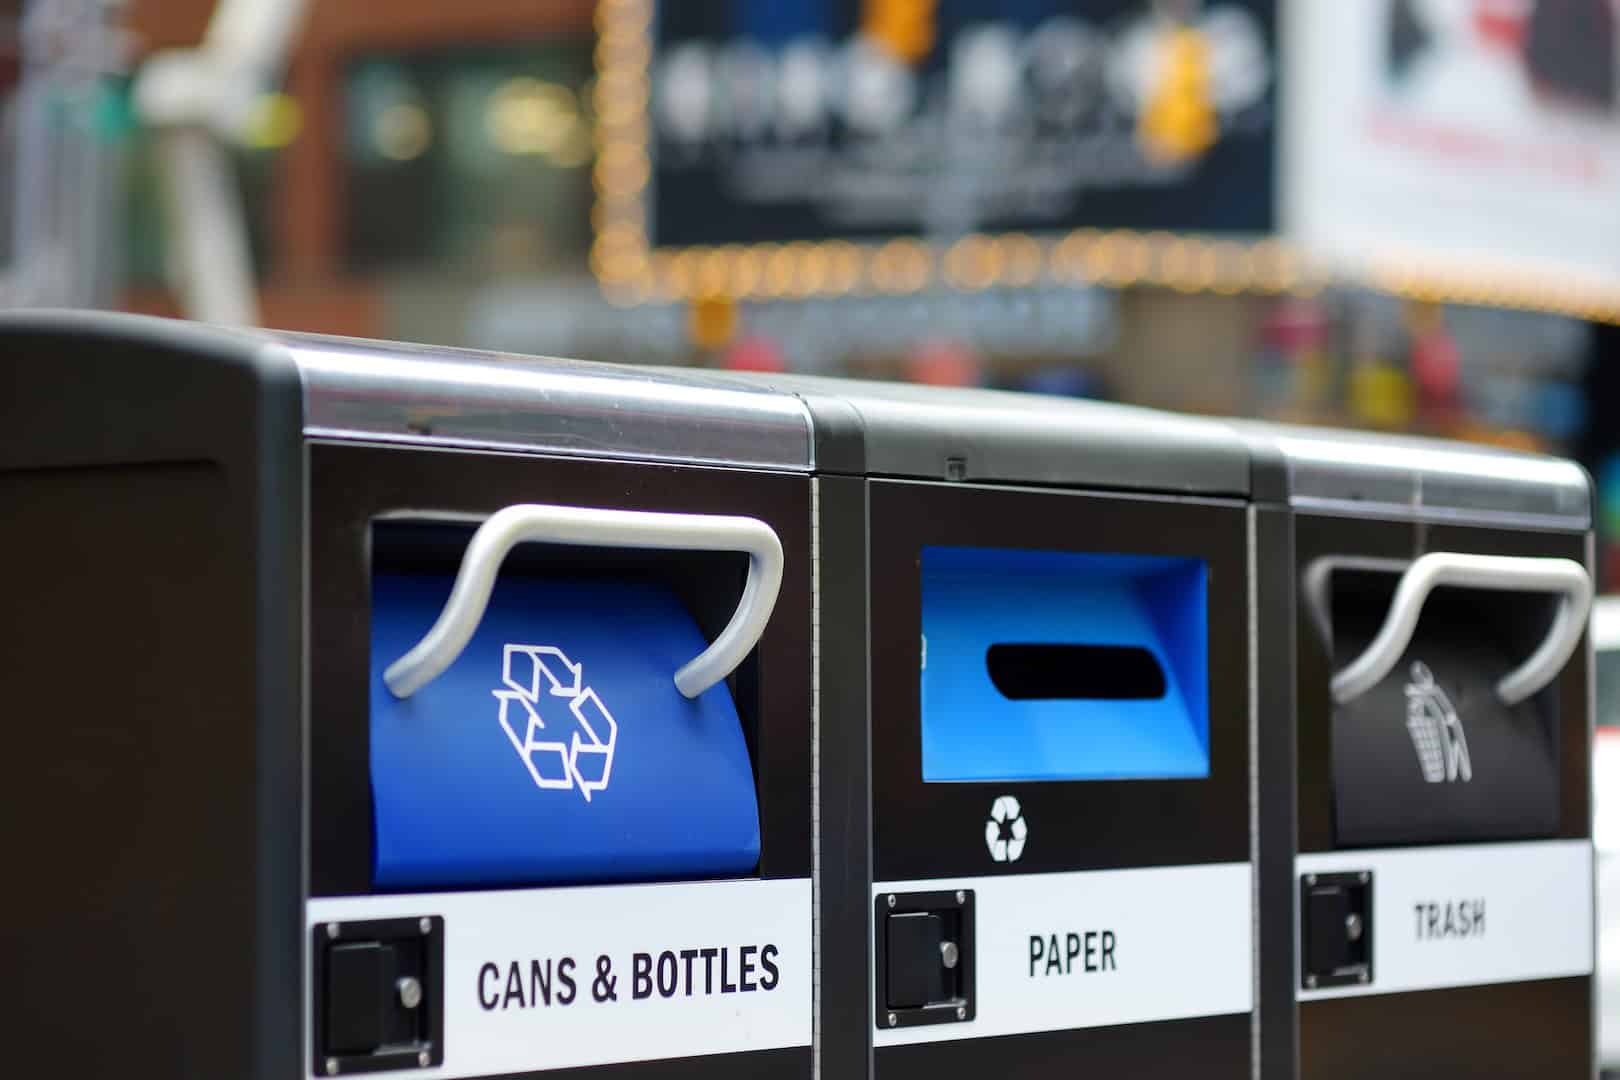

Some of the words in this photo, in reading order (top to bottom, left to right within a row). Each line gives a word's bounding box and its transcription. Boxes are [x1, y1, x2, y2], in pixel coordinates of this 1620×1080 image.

[1413, 899, 1486, 940] TRASH
[1029, 930, 1117, 977] PAPER
[478, 957, 576, 1011] CANS
[592, 955, 617, 1003] &
[632, 944, 779, 1000] BOTTLES
